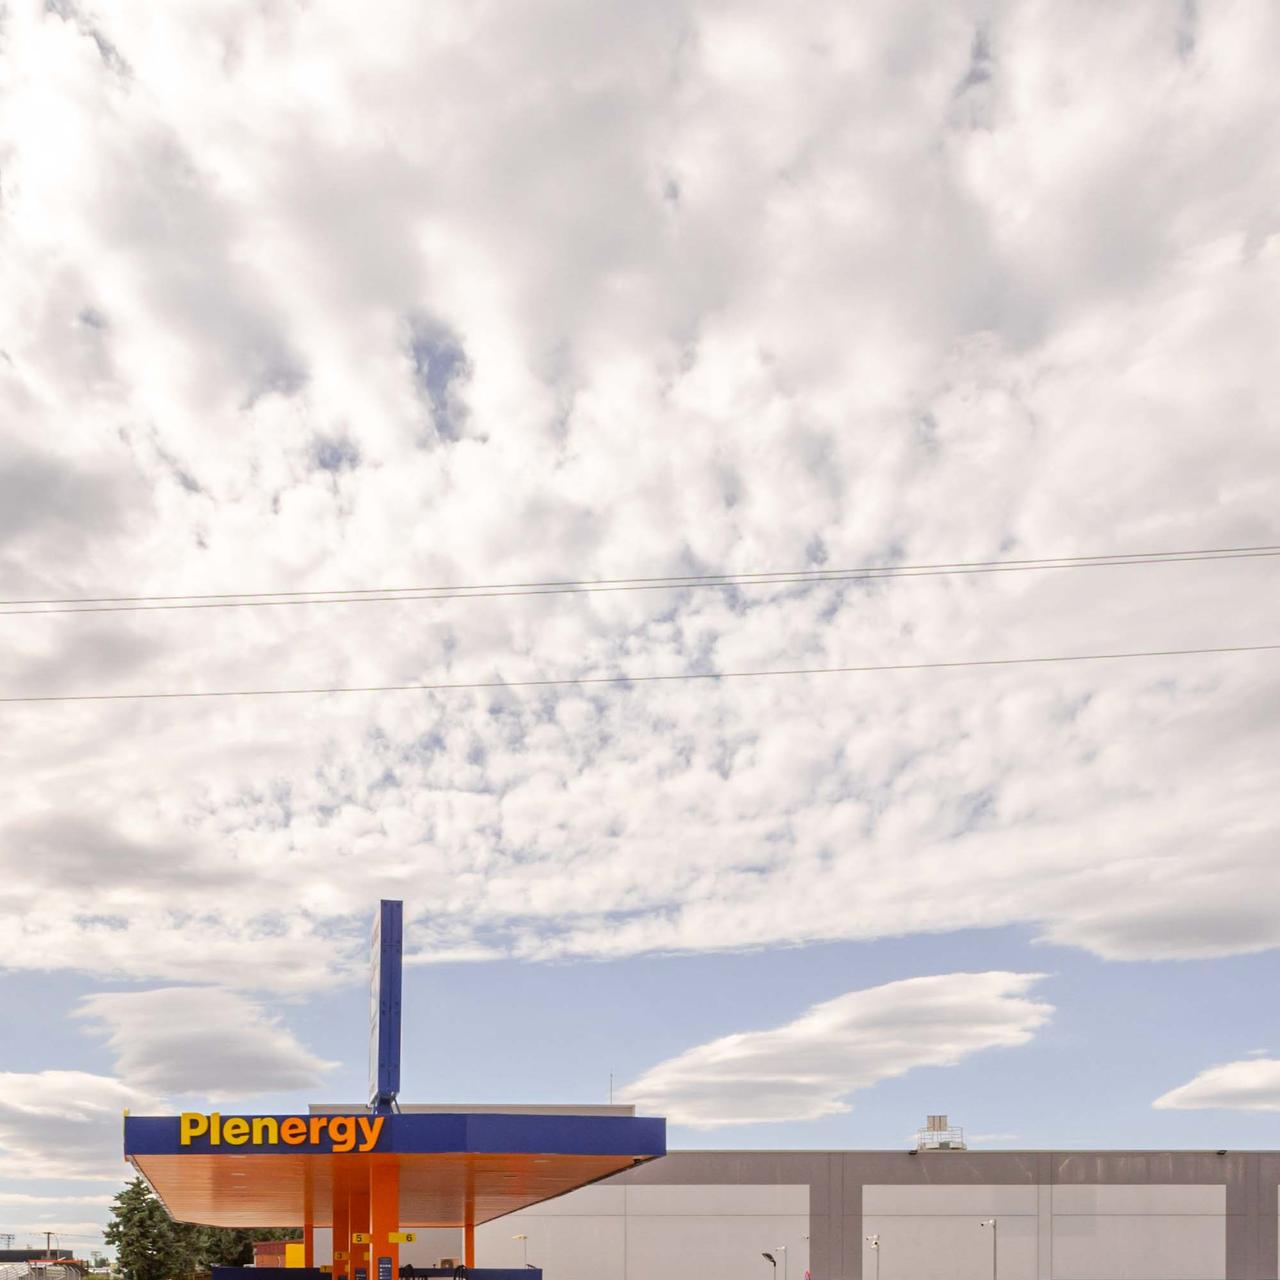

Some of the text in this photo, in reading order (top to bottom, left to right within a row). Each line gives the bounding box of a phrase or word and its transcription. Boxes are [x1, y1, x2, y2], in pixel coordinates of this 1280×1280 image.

[180, 1112, 385, 1153] Plenergy
[355, 1234, 362, 1242] 5
[406, 1234, 412, 1242] 6
